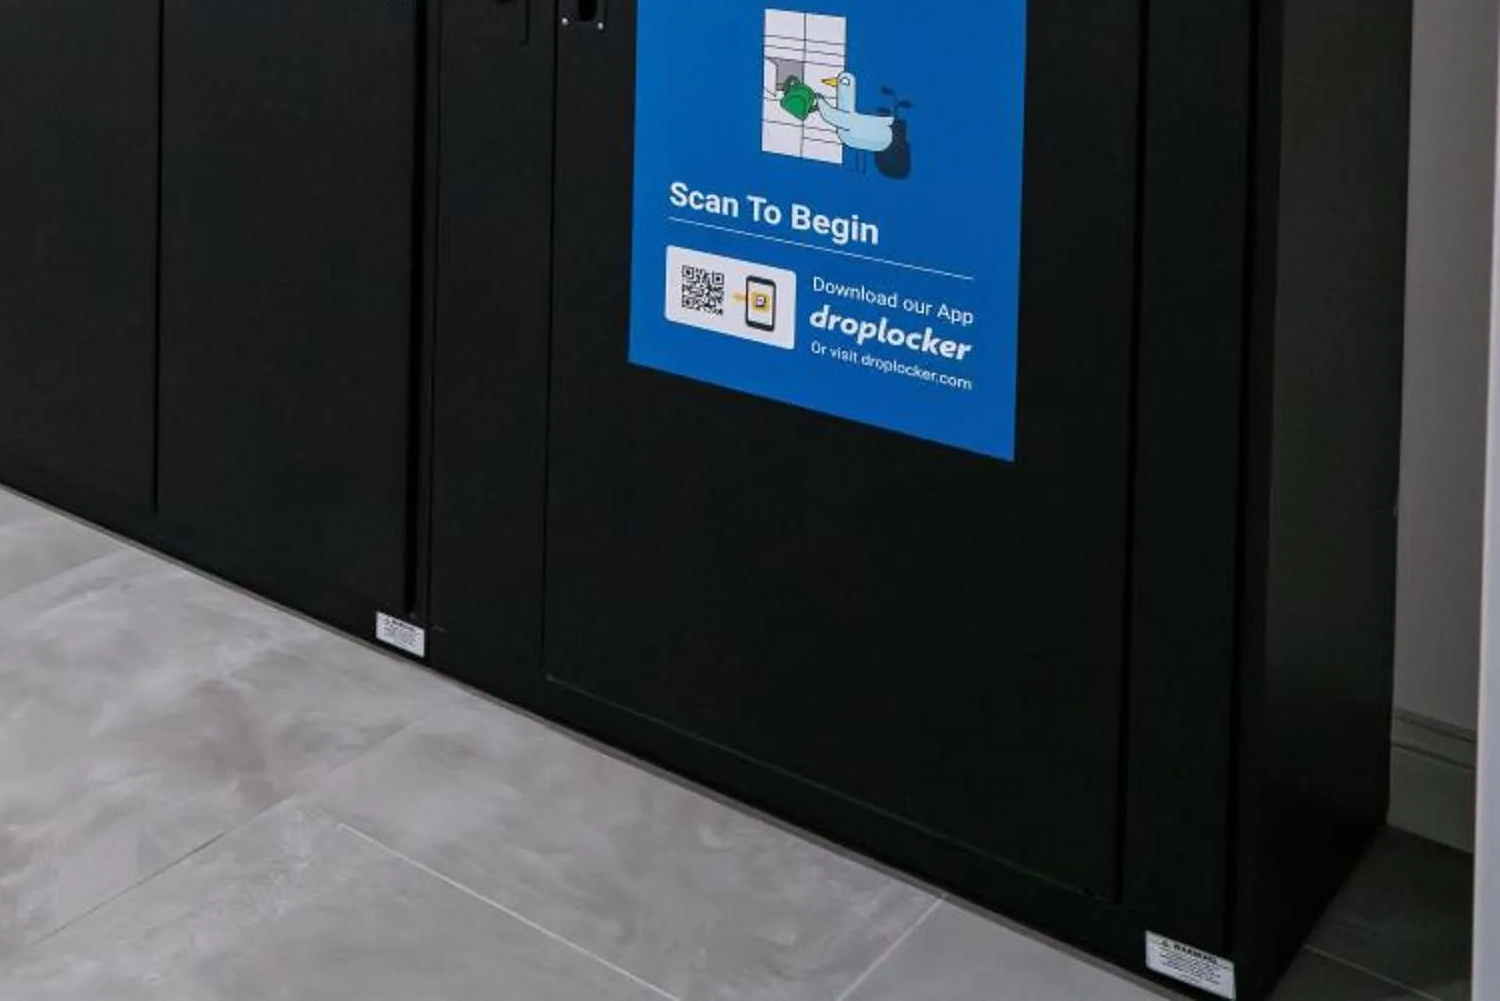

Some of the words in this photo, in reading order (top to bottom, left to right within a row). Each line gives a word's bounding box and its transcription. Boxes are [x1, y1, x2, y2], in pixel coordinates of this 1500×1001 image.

[668, 180, 740, 219] Scan
[746, 194, 783, 227] To
[790, 202, 880, 246] Begin
[812, 275, 899, 309] Download
[902, 298, 933, 317] our
[936, 302, 975, 327] App
[809, 303, 973, 361] droplocker
[810, 339, 827, 356] Or
[830, 344, 858, 364] visit
[861, 352, 973, 391] droplocker.com
